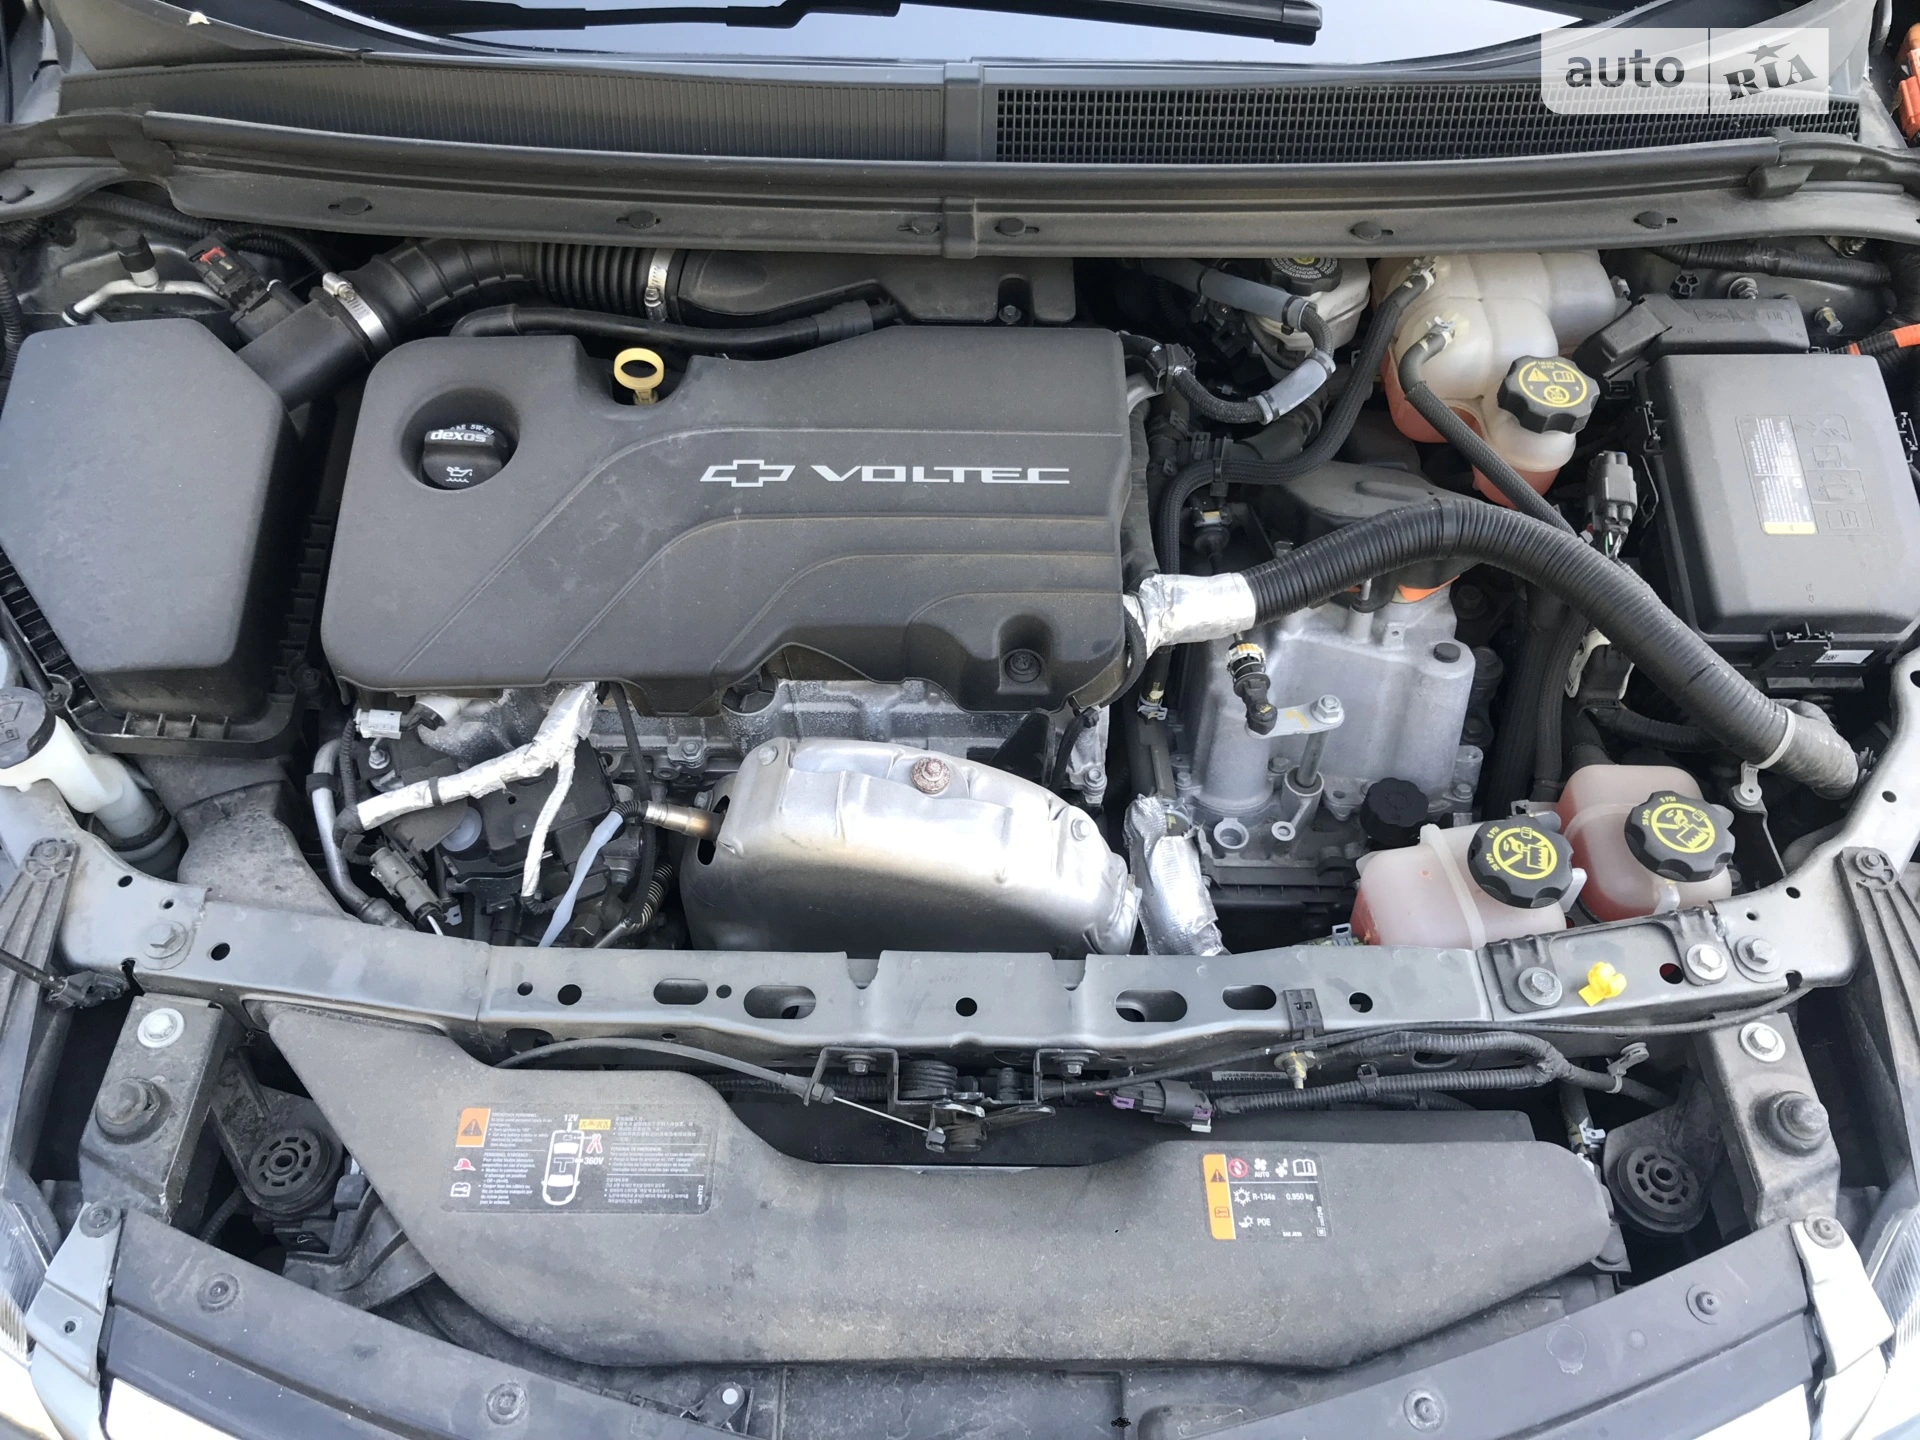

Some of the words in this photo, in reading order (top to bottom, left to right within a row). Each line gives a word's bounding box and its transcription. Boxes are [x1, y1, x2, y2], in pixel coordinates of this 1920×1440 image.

[430, 429, 487, 443] dexos
[810, 465, 1070, 484] VOLTEC
[564, 1113, 579, 1122] 12V
[583, 1157, 604, 1165] 360V
[1252, 1192, 1276, 1201] R-134a
[1286, 1192, 1305, 1201] 0.950
[1305, 1193, 1315, 1202] kg
[1257, 1218, 1272, 1227] POE
